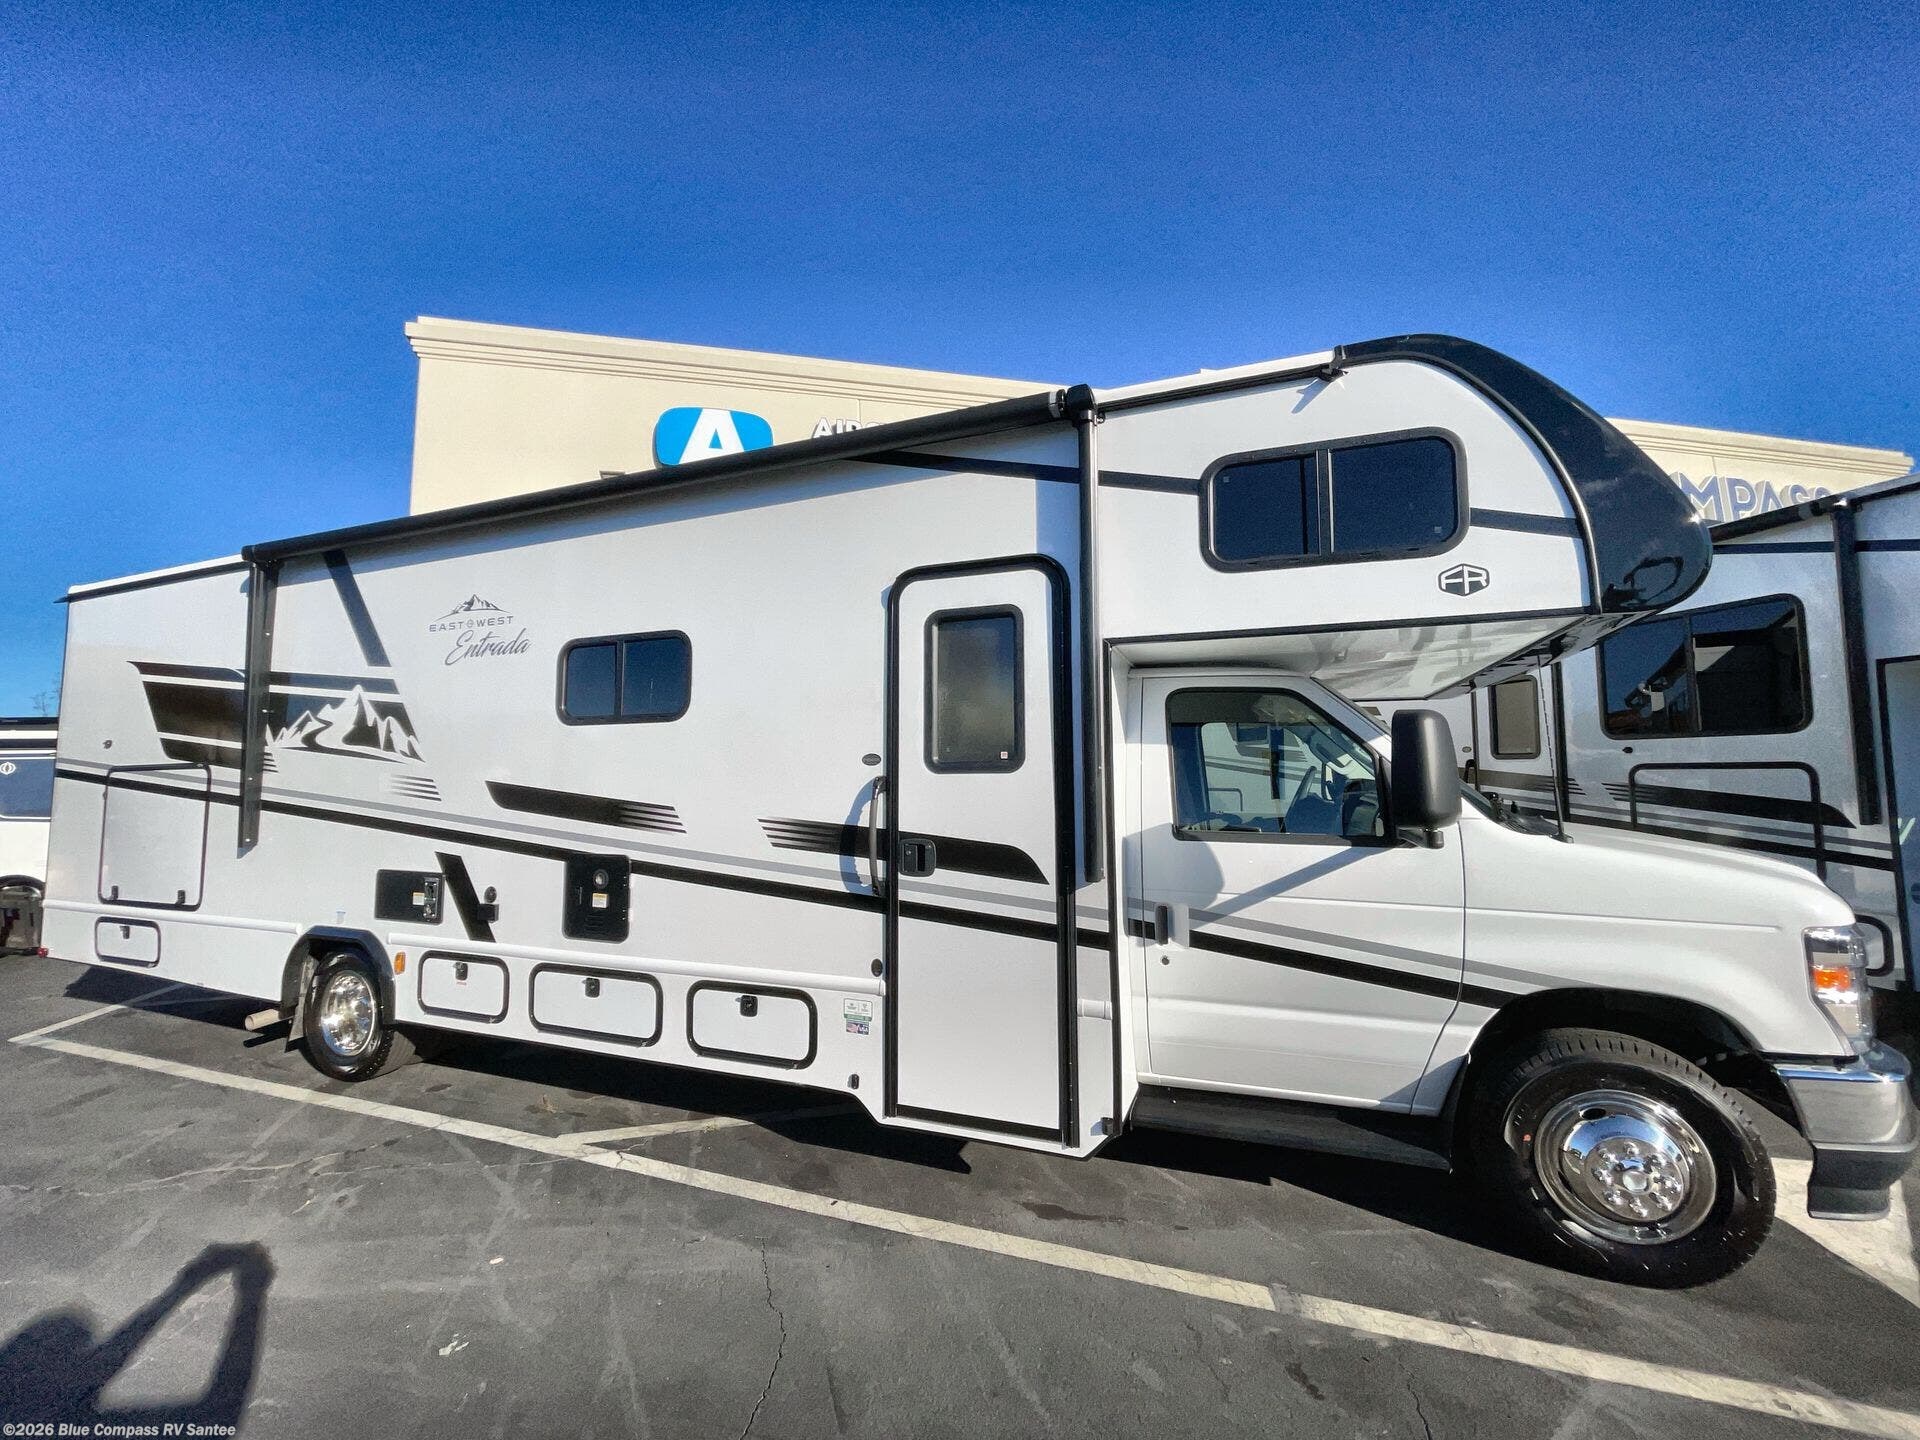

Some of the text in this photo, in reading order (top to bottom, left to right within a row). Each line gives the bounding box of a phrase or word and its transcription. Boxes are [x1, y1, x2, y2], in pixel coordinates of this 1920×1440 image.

[429, 621, 465, 632] EAST
[476, 616, 514, 627] WEST
[445, 628, 531, 666] Entrada
